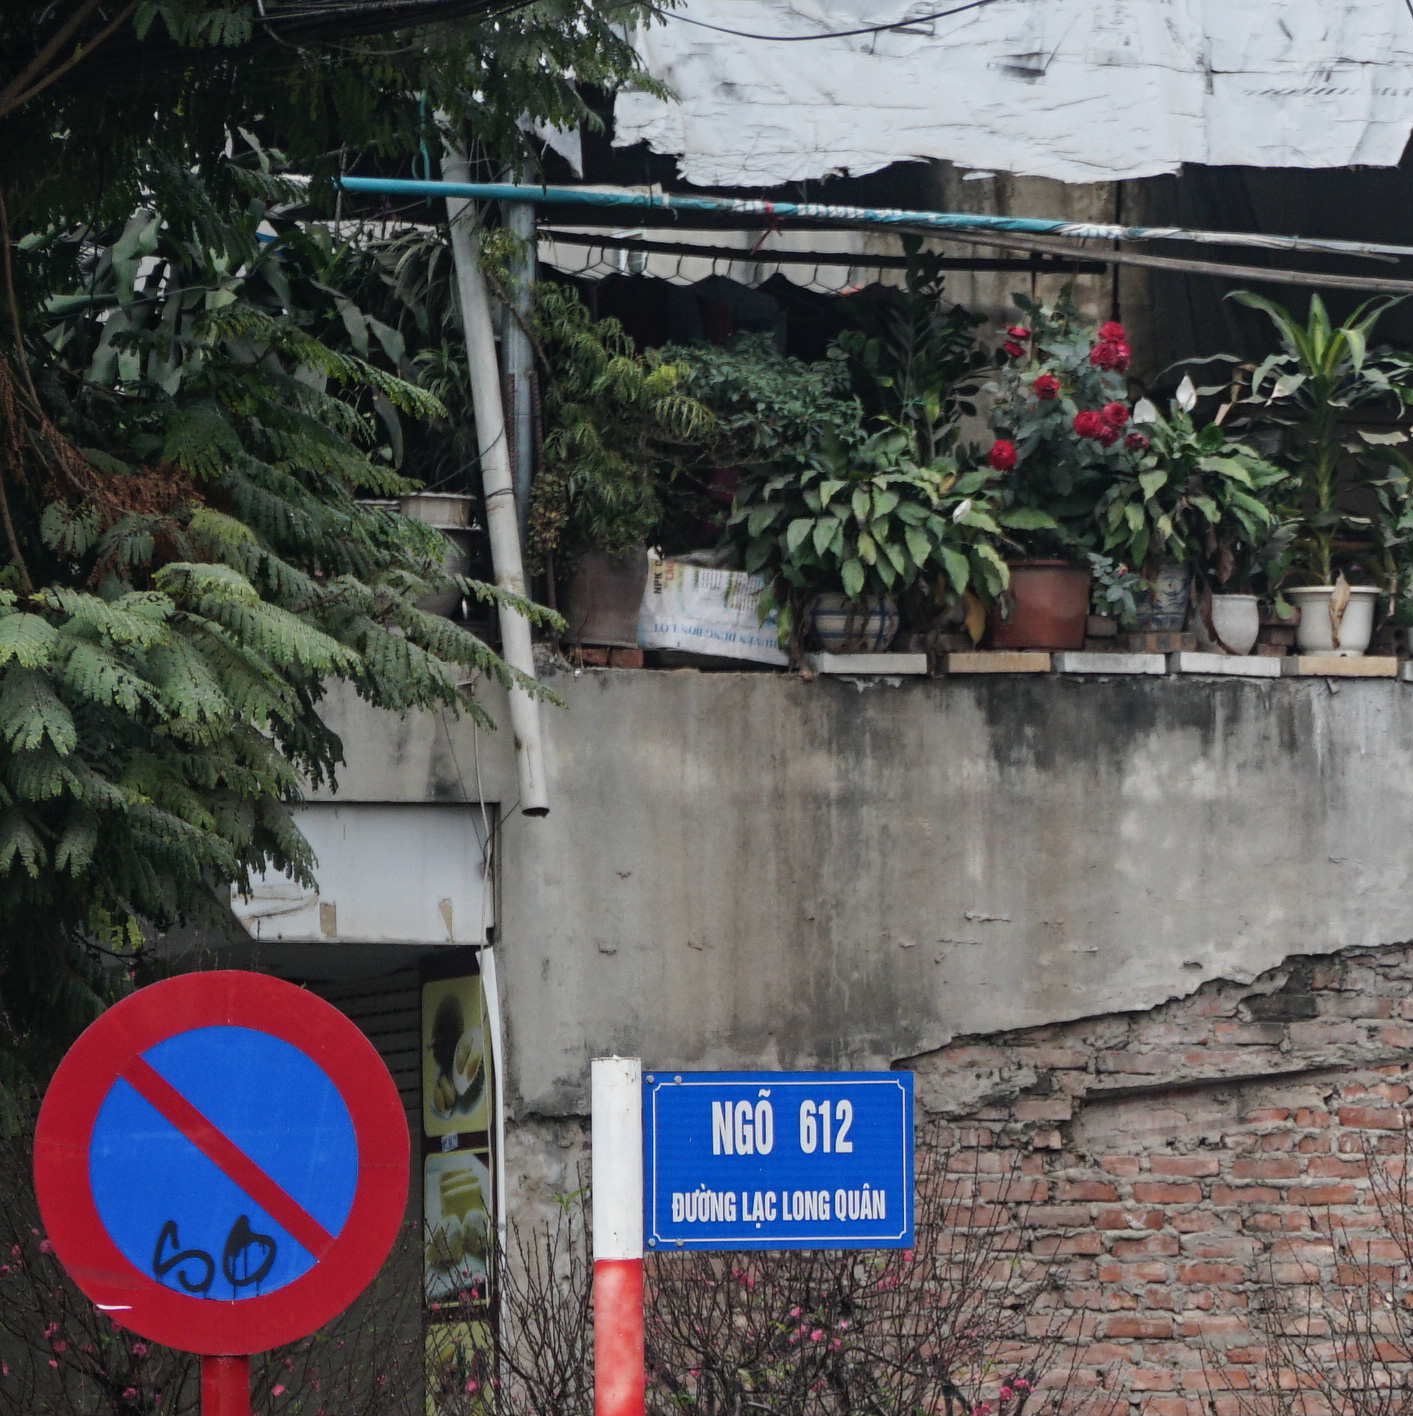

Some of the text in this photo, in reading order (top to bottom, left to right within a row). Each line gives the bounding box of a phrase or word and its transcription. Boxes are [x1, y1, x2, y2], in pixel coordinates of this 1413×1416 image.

[711, 1088, 854, 1156] NGÕ 612
[671, 1182, 886, 1229] ĐƯỜNG LẠC LONG QUÂN
